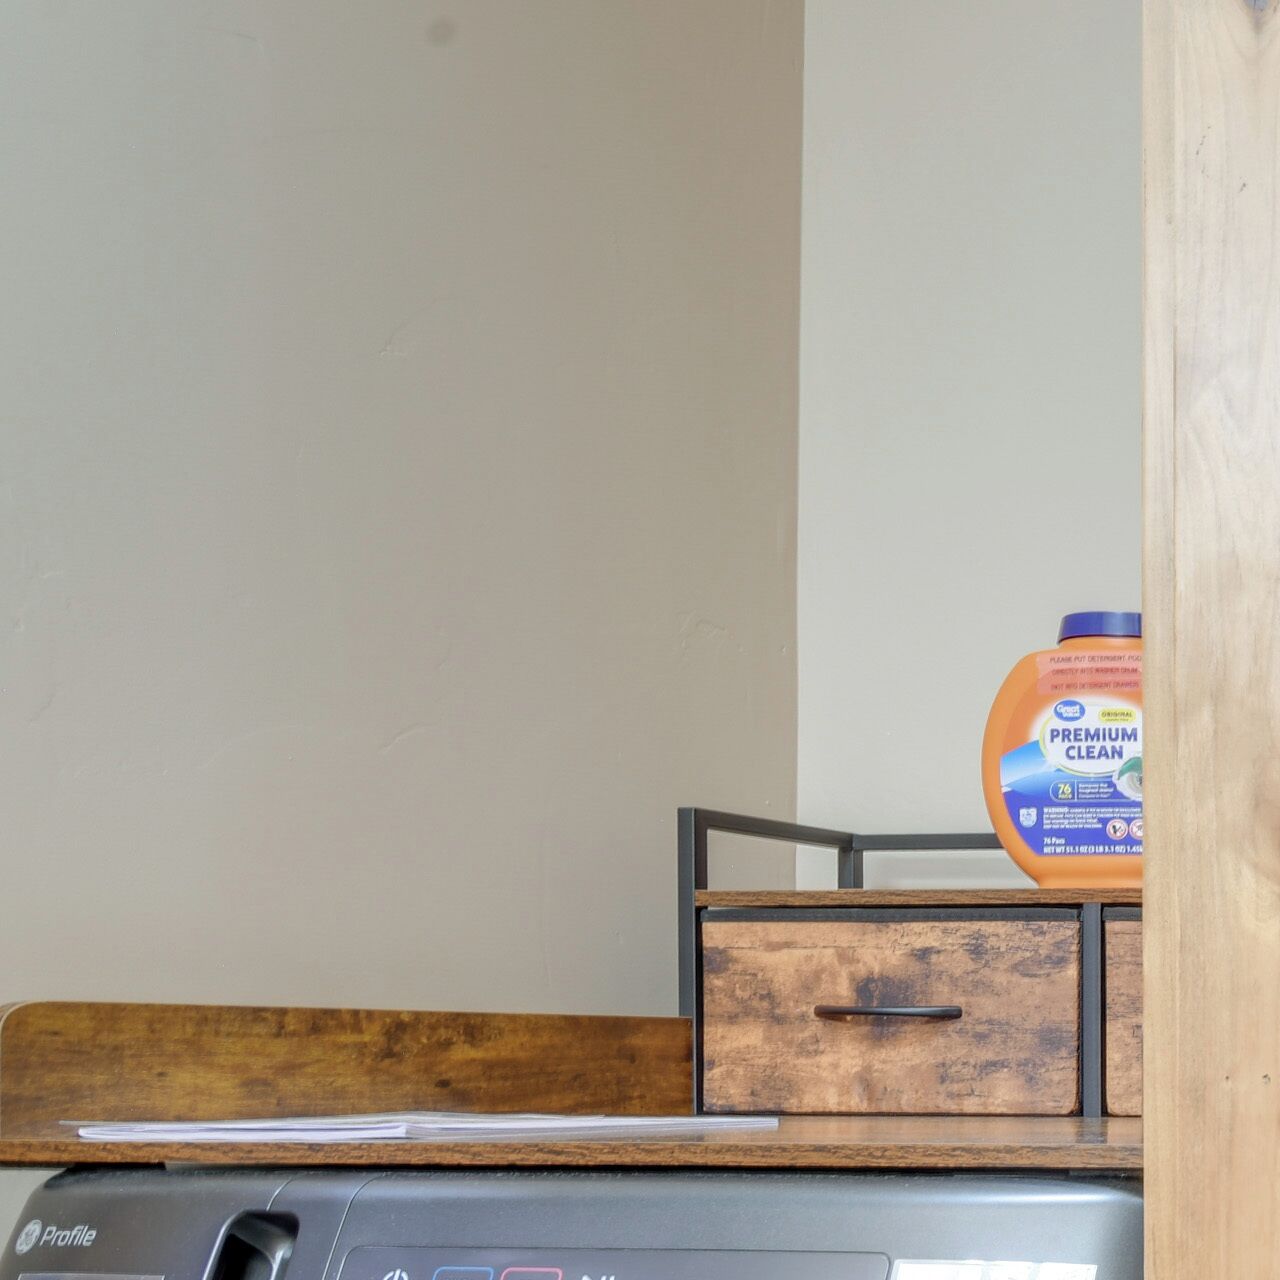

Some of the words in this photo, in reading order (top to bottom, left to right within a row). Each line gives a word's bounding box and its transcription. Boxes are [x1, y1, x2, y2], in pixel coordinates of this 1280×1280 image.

[1050, 727, 1138, 743] PREMIUM
[1065, 745, 1124, 760] CLEAN
[1058, 783, 1072, 794] 76
[40, 1225, 97, 1246] Profile
